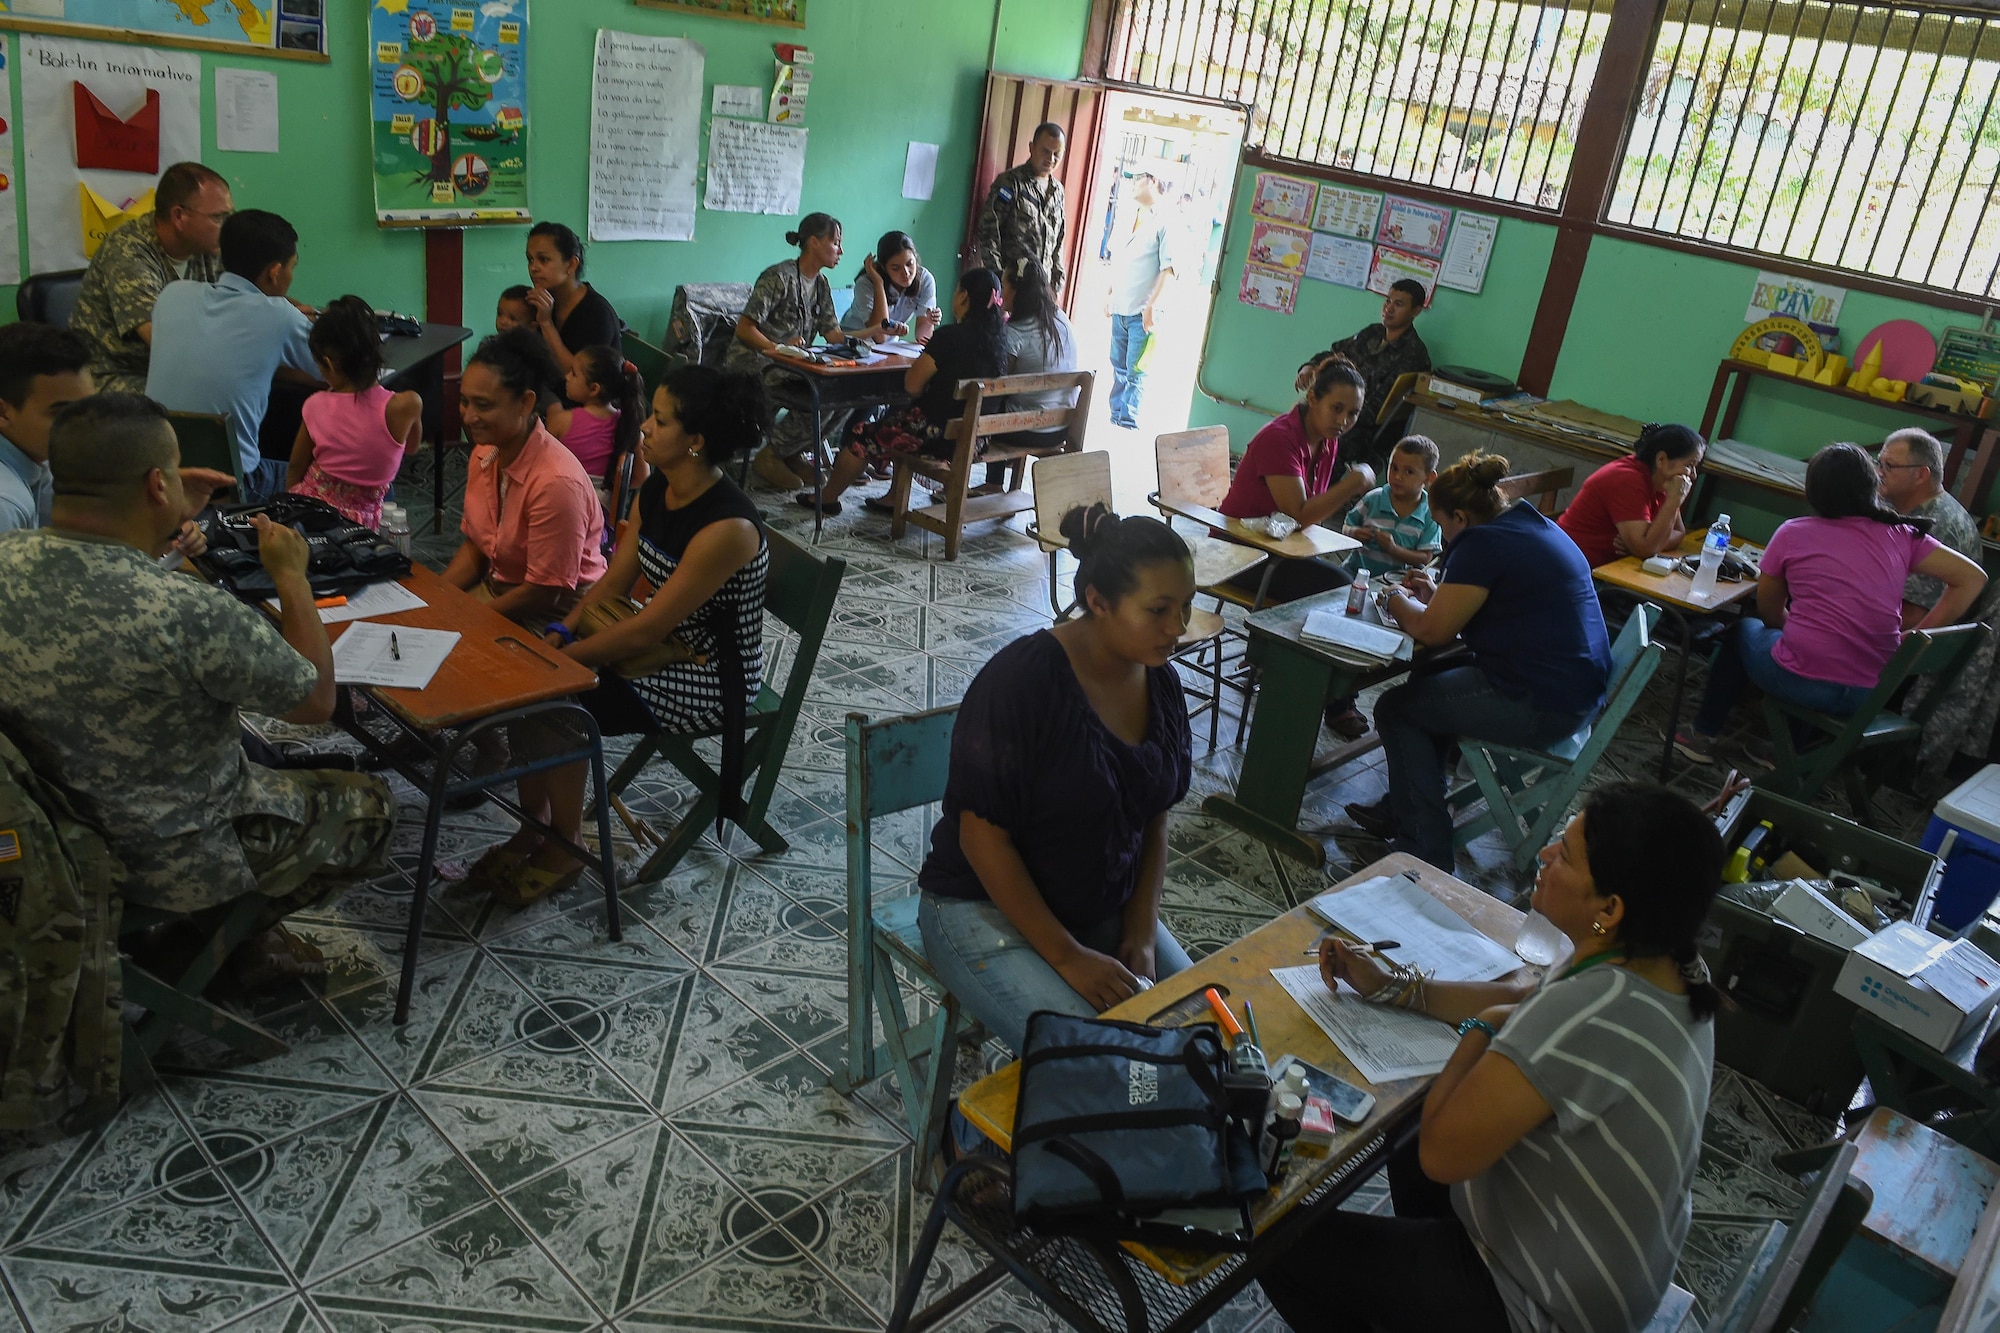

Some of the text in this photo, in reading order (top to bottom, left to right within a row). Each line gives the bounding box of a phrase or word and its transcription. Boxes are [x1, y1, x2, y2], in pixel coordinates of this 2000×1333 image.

[597, 55, 608, 68] La
[597, 72, 609, 84] La
[597, 90, 608, 102] La
[610, 95, 630, 103] vaca
[597, 107, 609, 118] La
[596, 139, 608, 150] La
